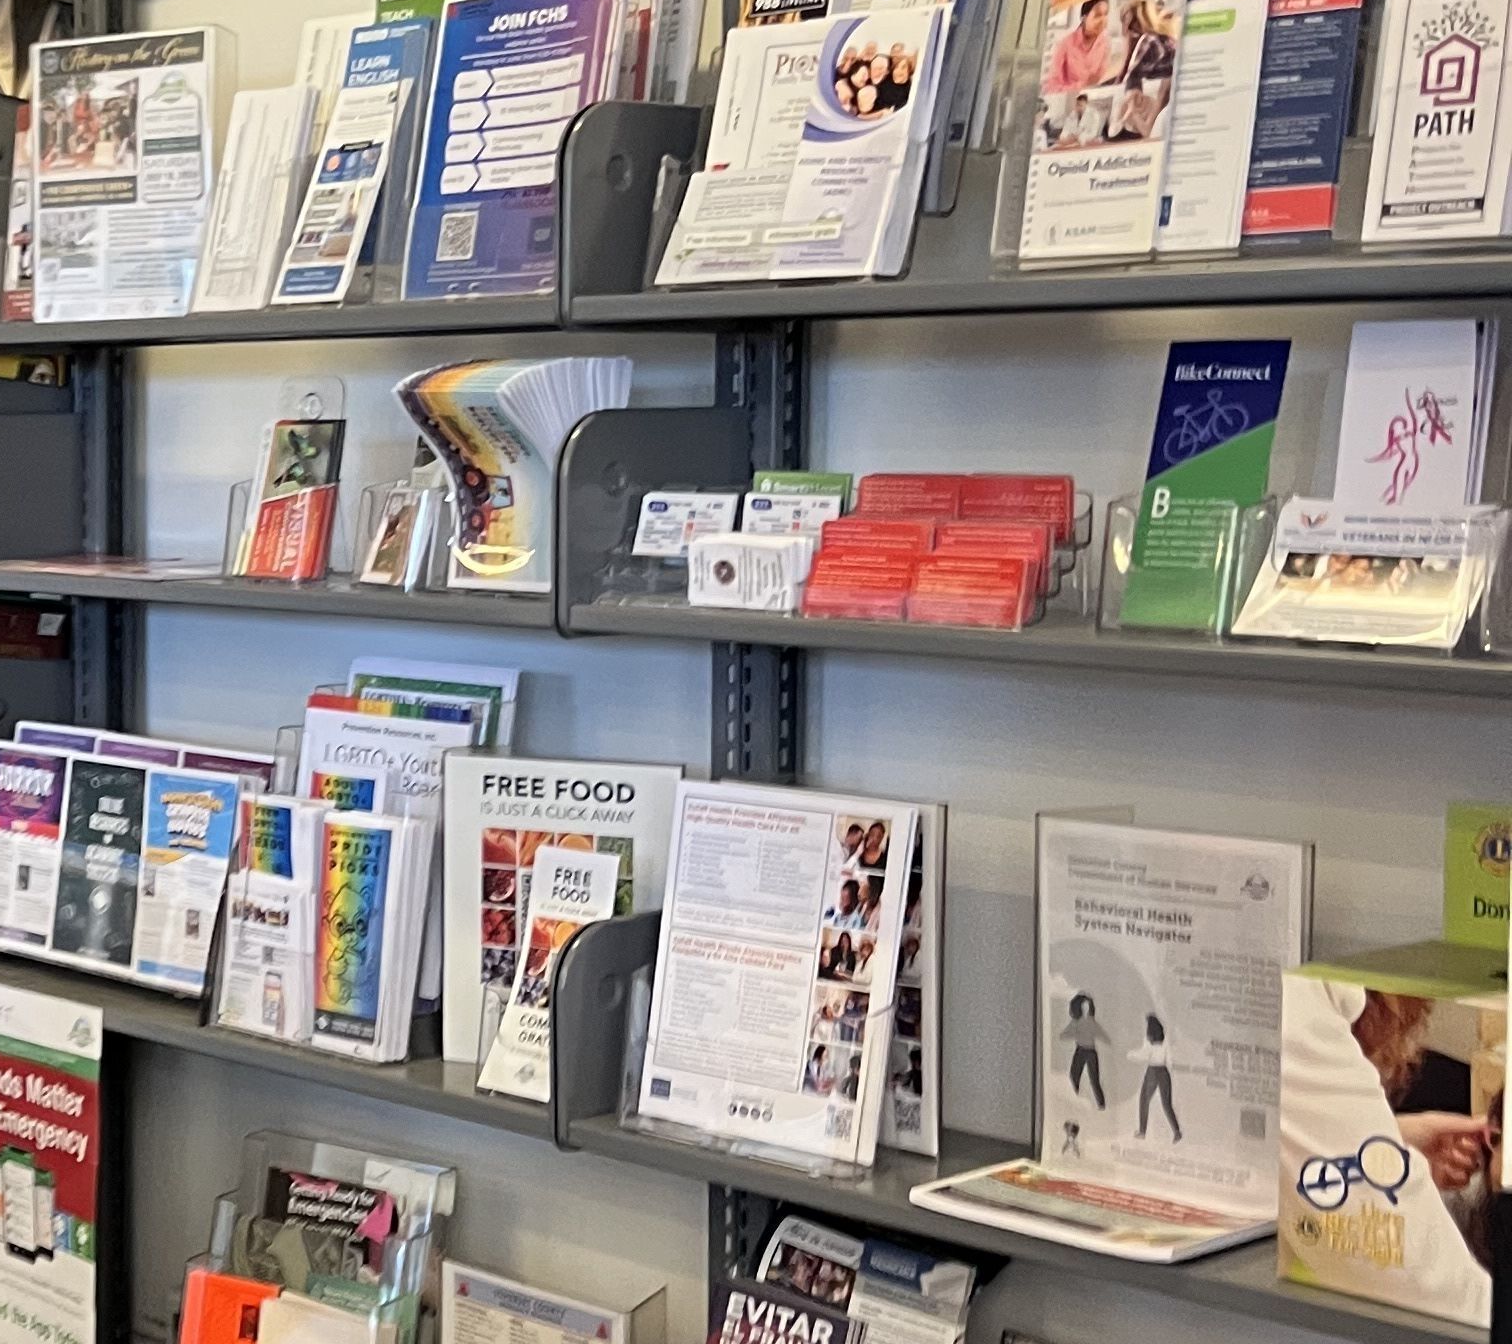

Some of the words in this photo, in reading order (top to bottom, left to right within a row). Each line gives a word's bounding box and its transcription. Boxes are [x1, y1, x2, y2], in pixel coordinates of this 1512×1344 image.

[488, 11, 528, 33] JOIN
[527, 3, 570, 28] FCHS
[350, 54, 392, 74] LEARN
[347, 68, 401, 88] ENGLISH
[1413, 109, 1476, 140] PATH
[1047, 159, 1090, 178] Opioid
[1090, 155, 1152, 173] Addiction
[1088, 174, 1150, 192] Treatment
[1174, 362, 1271, 382] BikeConnect
[1150, 486, 1171, 520] B
[399, 752, 443, 776] Yout
[482, 774, 546, 799] FREE
[555, 779, 636, 805] FOOD
[495, 803, 529, 817] JUST
[546, 806, 587, 822] CLICK
[590, 808, 636, 825] AWAY
[553, 866, 594, 887] FREE
[550, 885, 591, 905] FOOD
[1074, 896, 1144, 921] Behavioral
[1146, 904, 1193, 927] Health
[1073, 914, 1122, 934] System
[1125, 920, 1192, 945] Navigator
[24, 1073, 86, 1118] Matter
[721, 1316, 745, 1342] EL
